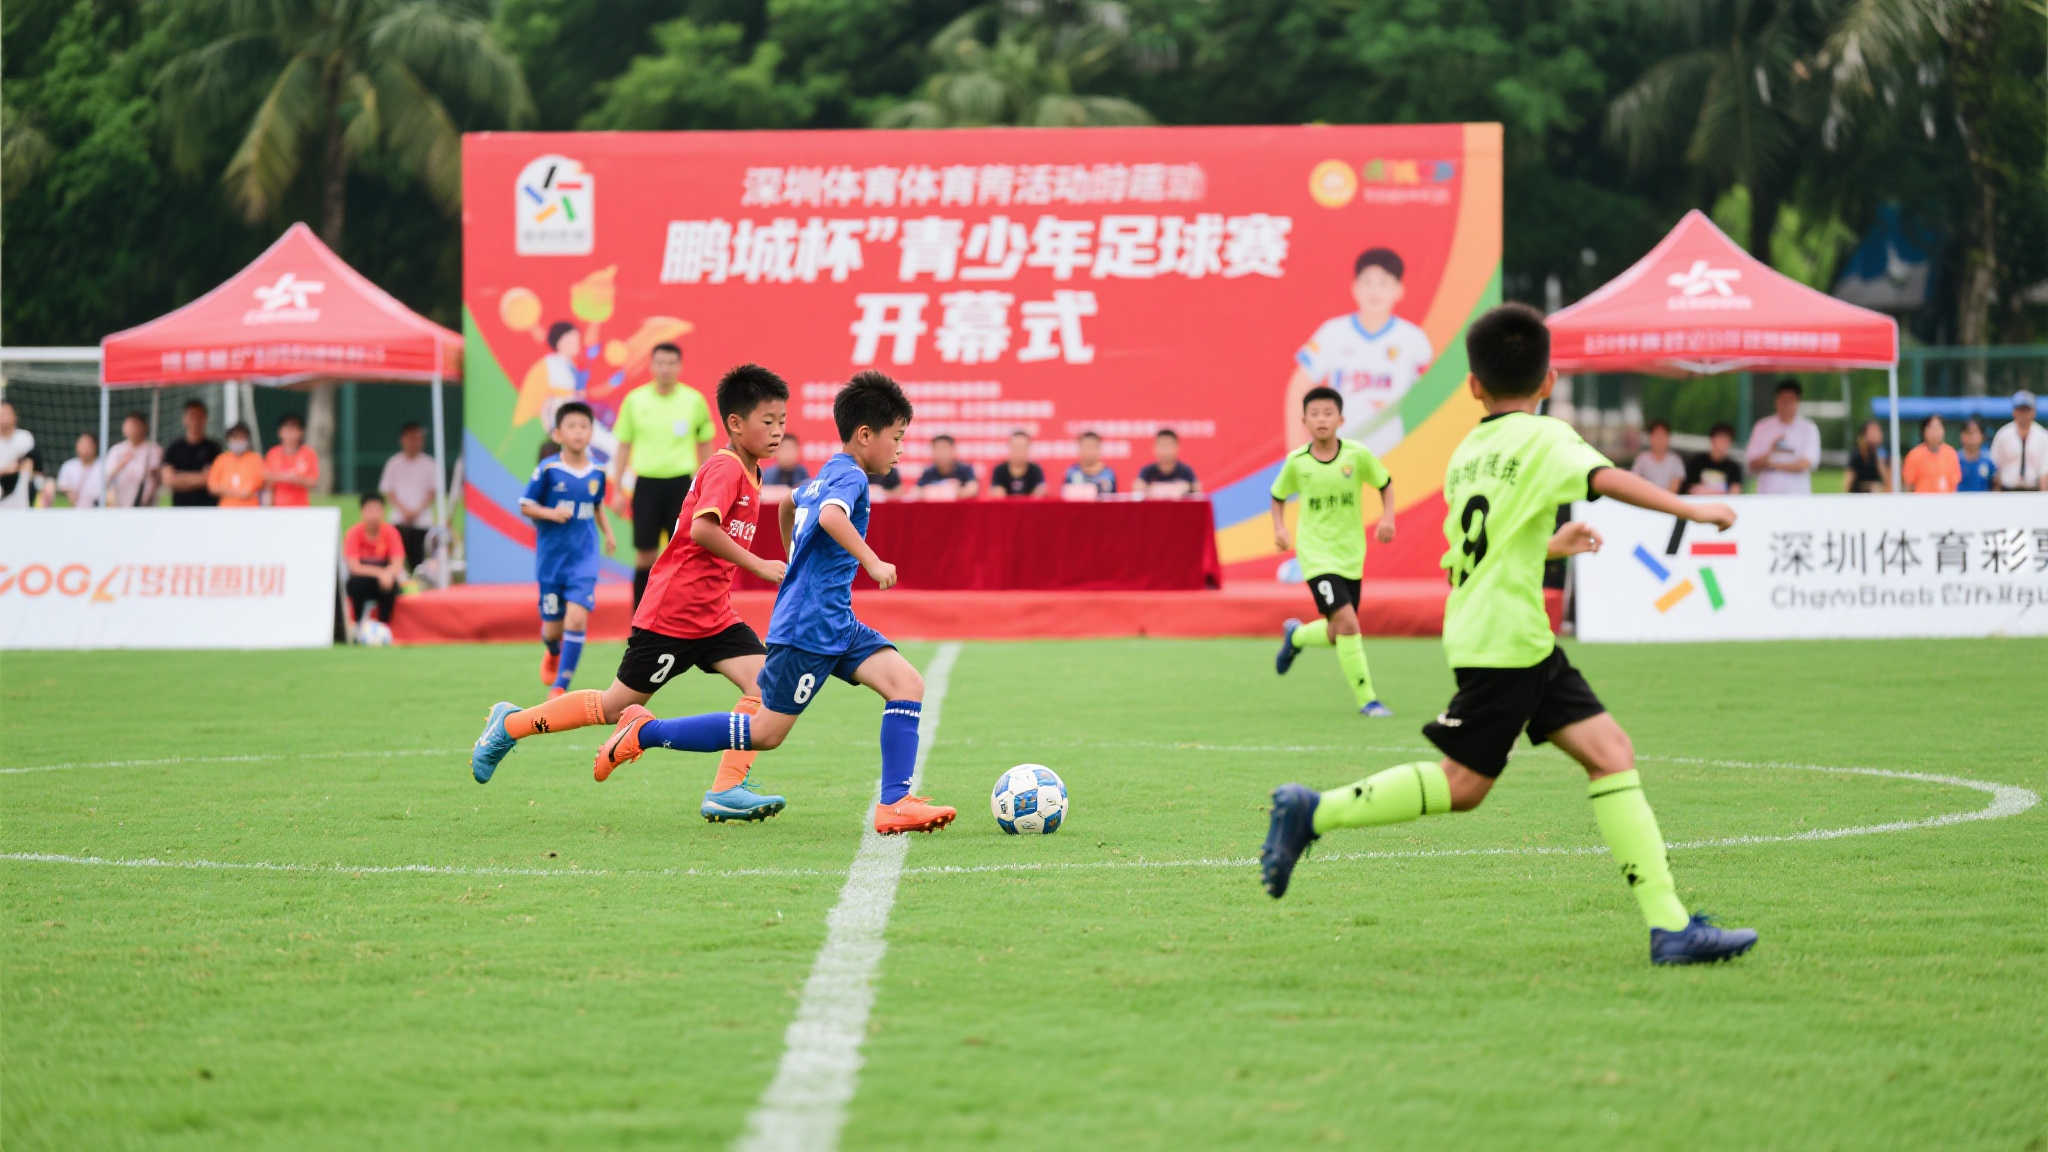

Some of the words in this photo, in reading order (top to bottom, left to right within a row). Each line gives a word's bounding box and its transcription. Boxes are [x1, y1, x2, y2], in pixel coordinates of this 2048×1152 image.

[850, 290, 1098, 364] 开幕式
[1317, 579, 1335, 606] 9
[650, 653, 676, 684] 2
[793, 673, 816, 705] 6
